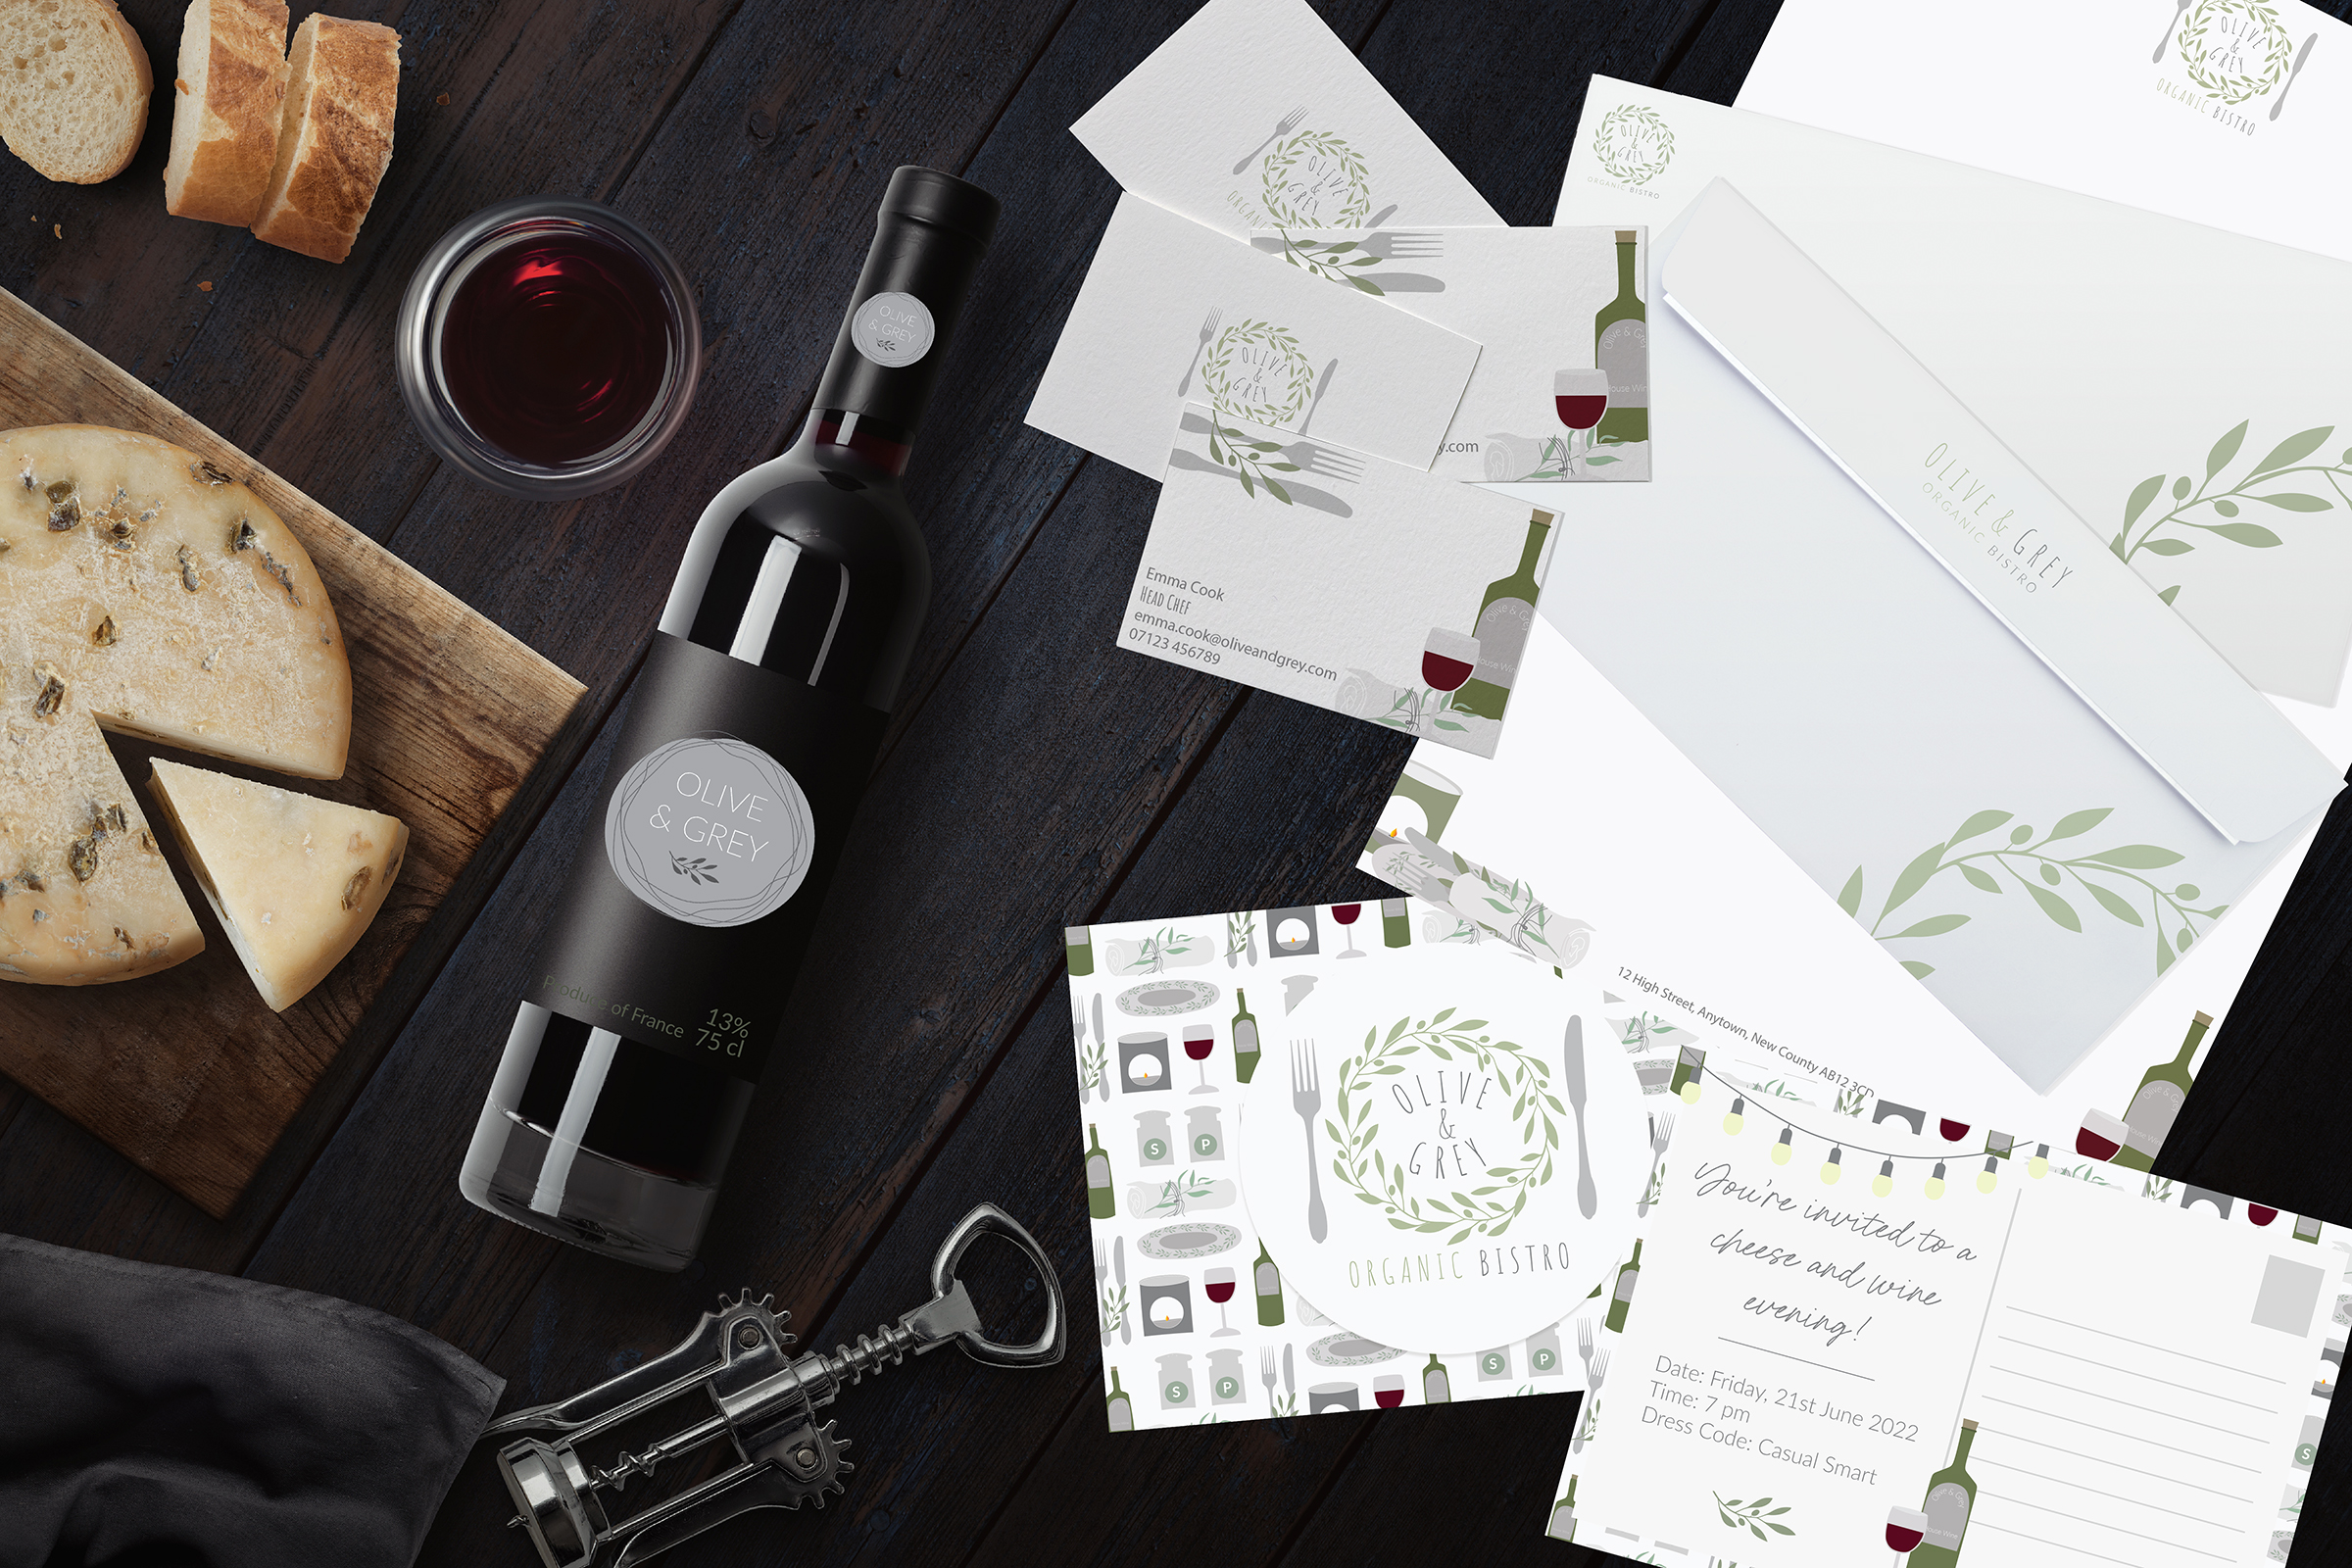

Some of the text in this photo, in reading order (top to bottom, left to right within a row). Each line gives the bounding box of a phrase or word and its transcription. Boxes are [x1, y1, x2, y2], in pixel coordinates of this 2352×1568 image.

[2221, 16, 2267, 49] OLIVE
[2230, 38, 2240, 55] &
[2209, 47, 2243, 74] GREY
[2156, 77, 2256, 136] ORGANIC BISTRO
[1620, 124, 1655, 143] OLIVE
[1617, 146, 1643, 163] GREY
[1307, 155, 1348, 196] OLIVE
[1310, 180, 1323, 195] &
[1587, 175, 1660, 200] ORGANIC BISTRO
[1227, 190, 1273, 229] ORGANI
[1287, 182, 1320, 216] GREY
[868, 318, 916, 343] & GREY
[879, 305, 917, 327] OLIVE
[1603, 328, 1621, 350] Olive
[1623, 326, 1631, 336] &
[1242, 346, 1287, 376] OLIVE
[1253, 368, 1262, 383] &
[1233, 377, 1267, 403] GREY
[1925, 442, 2074, 589] OLIVE & GREY
[1922, 482, 2037, 593] ORGANIC BISTRO
[1146, 566, 1225, 602] Emma Cook
[1486, 604, 1507, 622] Olive
[1509, 605, 1516, 615] &
[1128, 627, 1221, 665] 07123 456789
[1134, 611, 1339, 682] emma.cook@oliveandgrey.com
[676, 771, 769, 822] OLIVE
[649, 804, 769, 862] & GREY
[542, 974, 685, 1039] Produce of France
[706, 1008, 752, 1039] 13%
[1617, 966, 1633, 981] 12
[1632, 973, 1660, 999] High
[1660, 987, 1696, 1013] Street,
[1696, 1005, 1749, 1041] Anytown,
[1750, 1032, 1779, 1052] New
[1778, 1046, 1820, 1075] County
[1818, 1066, 1849, 1088] AB12
[695, 1027, 746, 1058] 75 cl
[1392, 1070, 1493, 1114] OLIVE
[2142, 1086, 2162, 1100] Olive
[1439, 1108, 1456, 1140] &
[1150, 1144, 1159, 1155] S
[1200, 1139, 1210, 1151] P
[1408, 1137, 1487, 1179] GREY
[1803, 1199, 1915, 1248] invited
[1919, 1229, 1954, 1253] to
[1956, 1248, 1978, 1261] a
[1348, 1242, 1569, 1289] ORGANIC BISTRO
[1710, 1229, 1942, 1305] cheese and wine
[1742, 1296, 1873, 1347] evening!
[1489, 1358, 1497, 1370] S
[1540, 1353, 1549, 1366] P
[1172, 1386, 1181, 1397] S
[1223, 1382, 1232, 1394] P
[1649, 1379, 1751, 1424] Time: 7 pm
[1654, 1354, 1920, 1443] Date: Friday, 21st June 2022
[1642, 1405, 1878, 1487] Dress Code: Casual Smart
[2301, 1447, 2312, 1460] S
[1931, 1488, 1947, 1502] Olive
[1942, 1530, 1958, 1541] Wine
